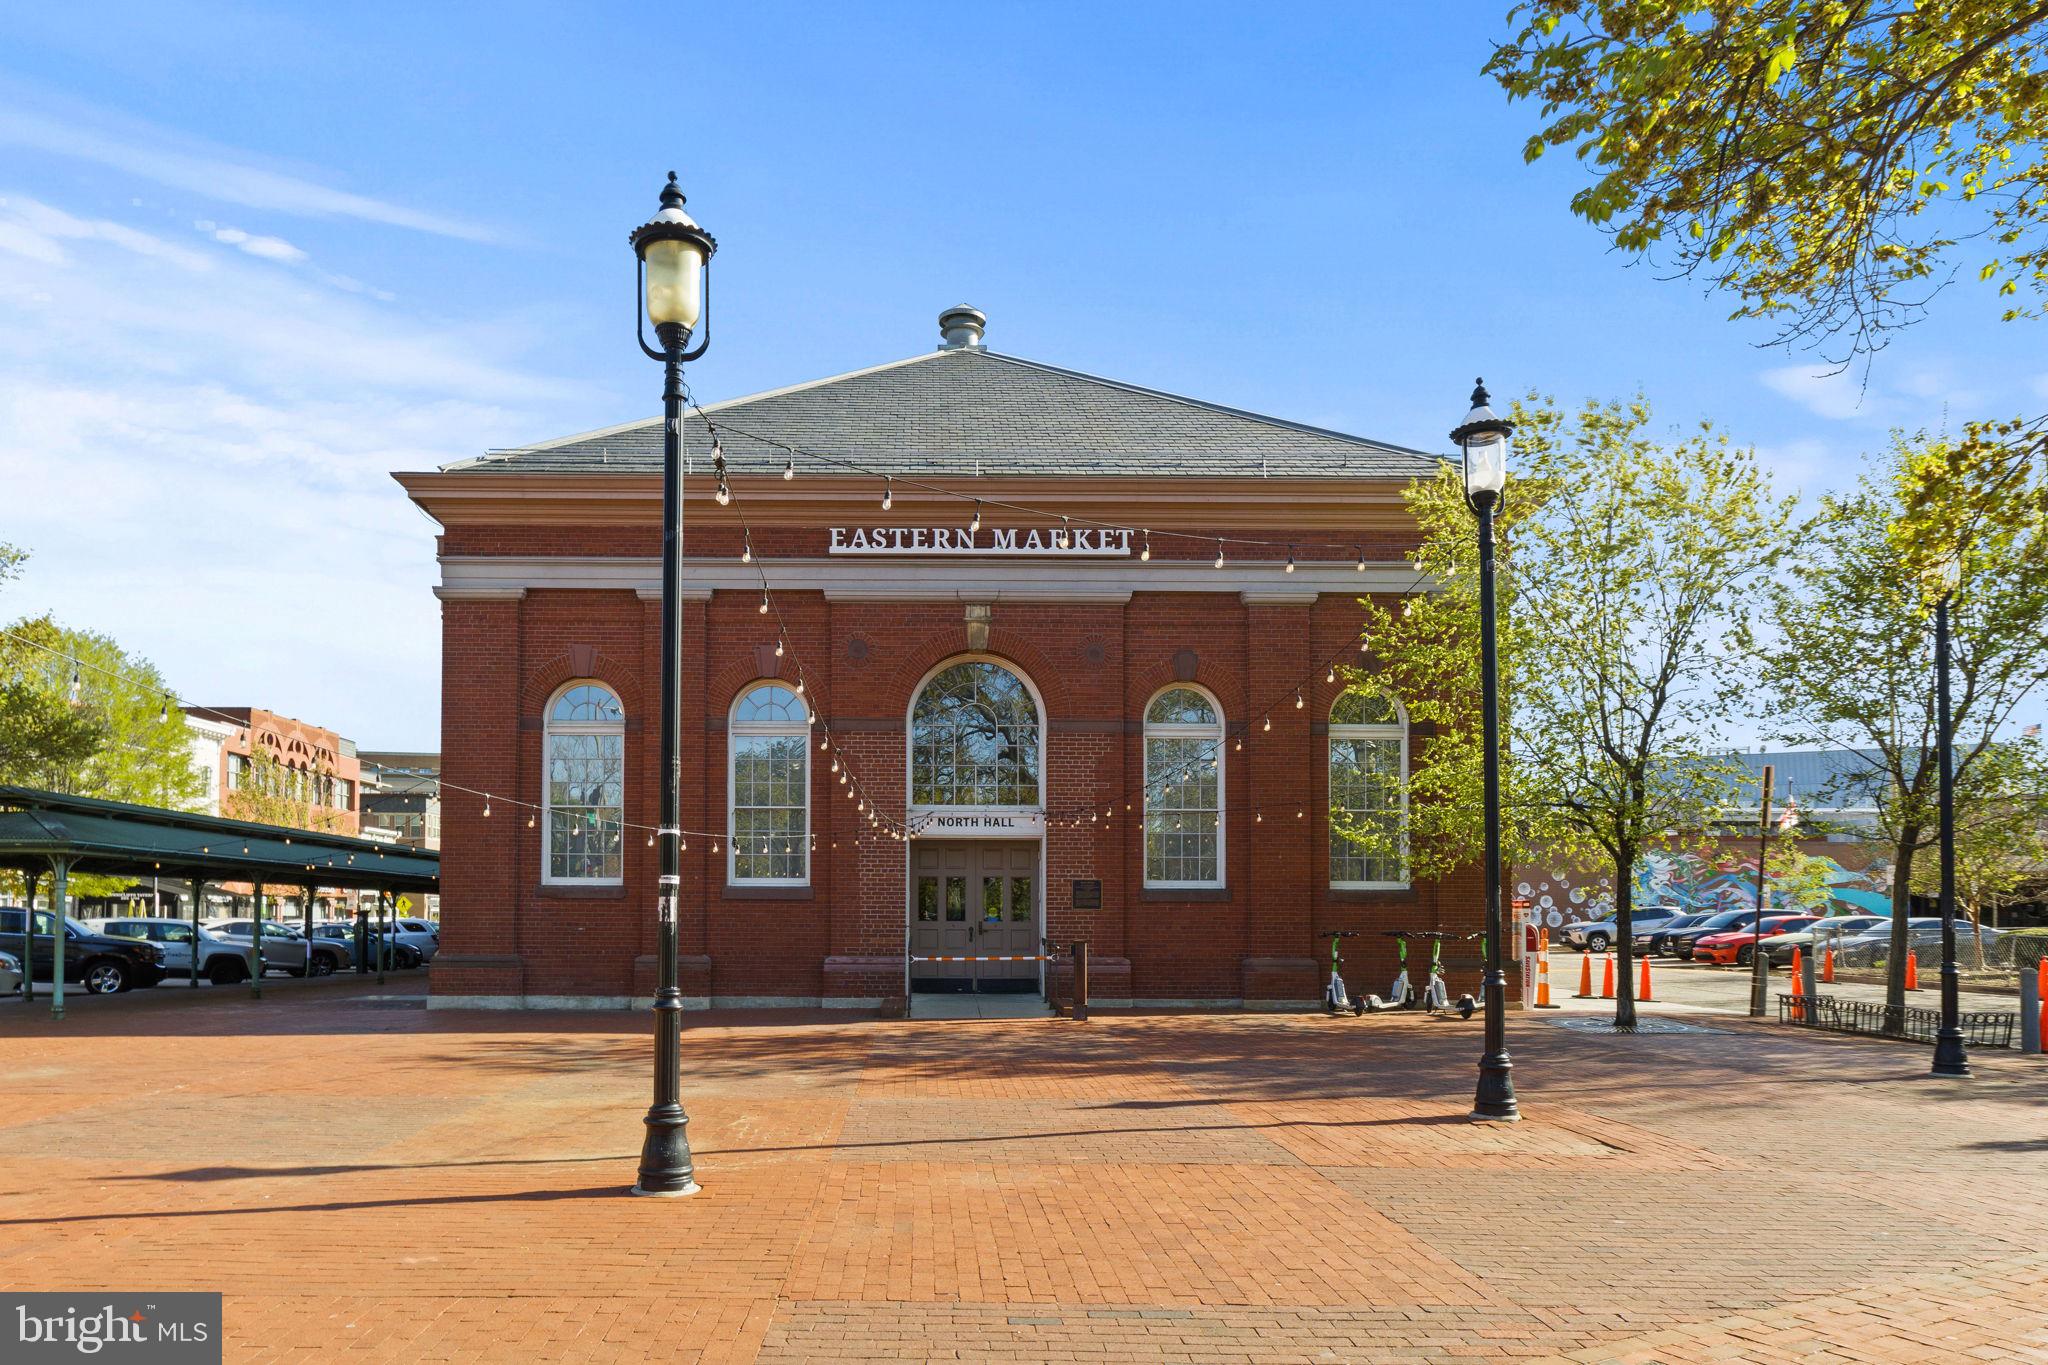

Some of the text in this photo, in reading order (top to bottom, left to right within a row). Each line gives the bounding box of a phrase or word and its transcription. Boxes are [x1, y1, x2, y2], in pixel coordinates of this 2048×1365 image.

[829, 528, 1134, 550] EASTERN MARKET
[937, 817, 1015, 827] NORTH HALL
